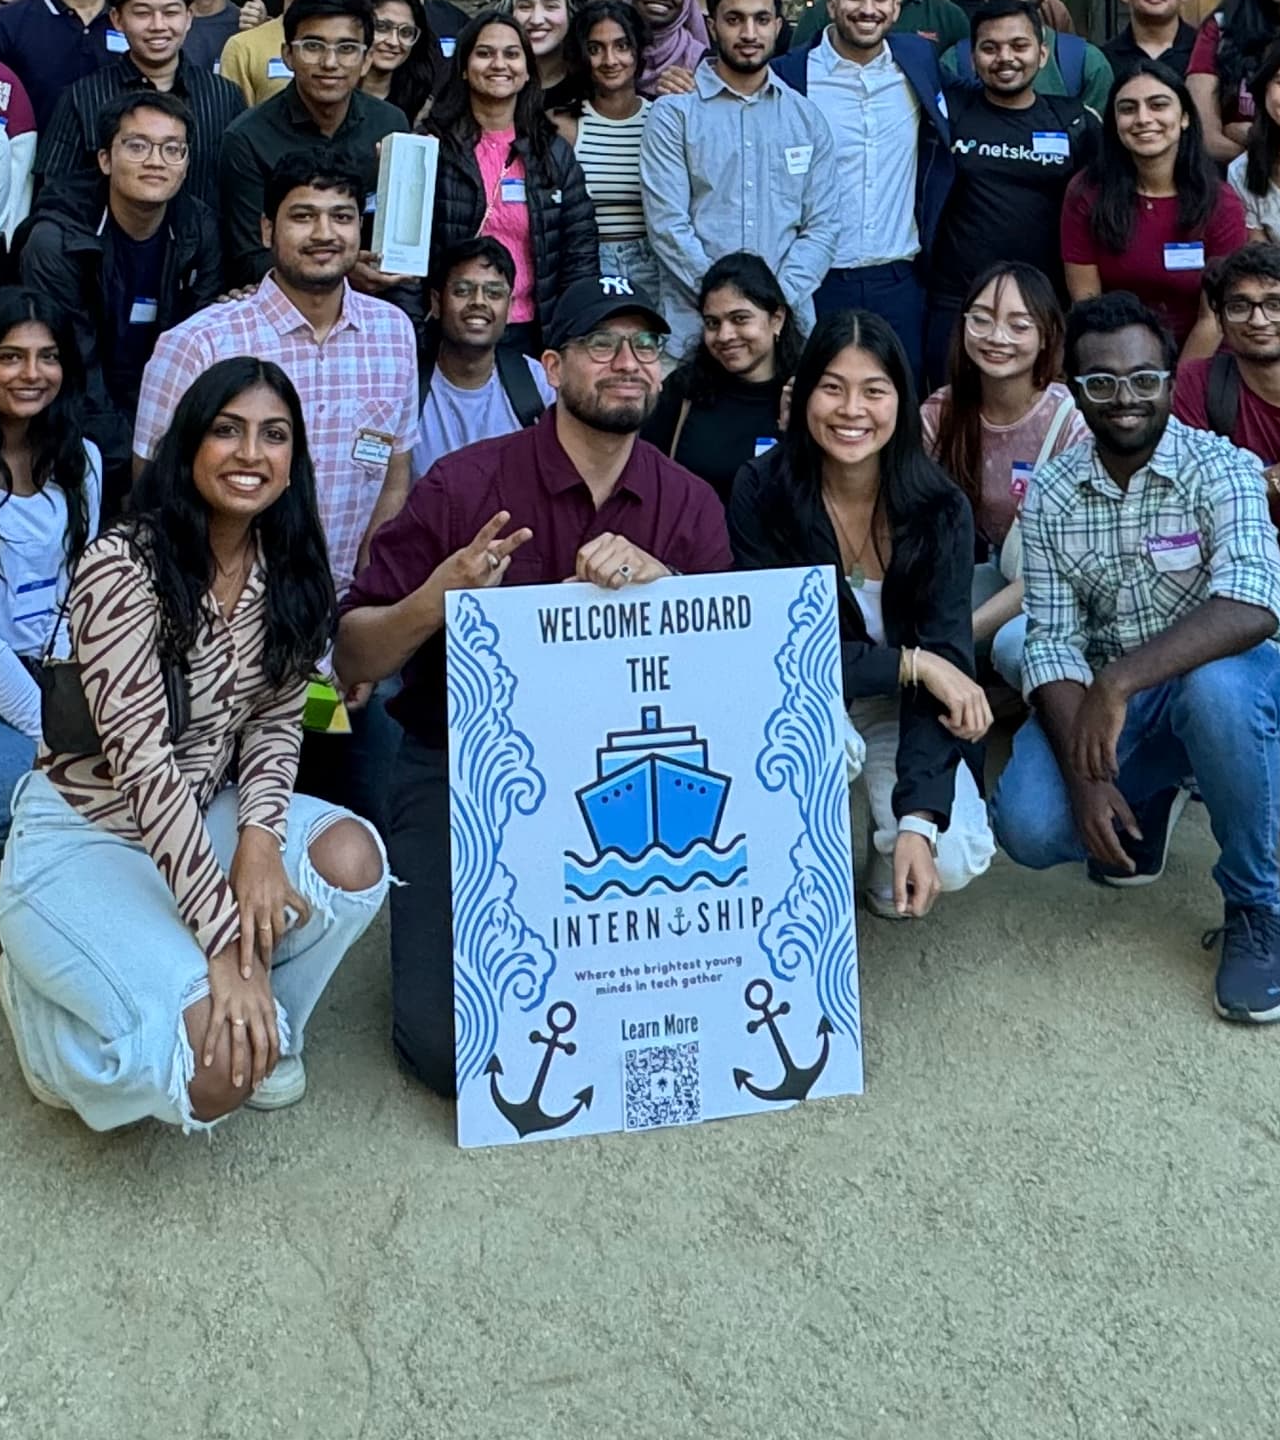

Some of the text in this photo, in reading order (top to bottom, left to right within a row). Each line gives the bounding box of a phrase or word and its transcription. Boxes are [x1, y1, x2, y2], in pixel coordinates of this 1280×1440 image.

[978, 143, 1065, 165] netskope
[538, 594, 752, 644] WELCOME ABOARD
[626, 655, 671, 693] THE
[574, 955, 743, 982] Where the brightest young
[595, 972, 723, 996] minds in tech gather
[621, 1013, 699, 1041] Learn More
